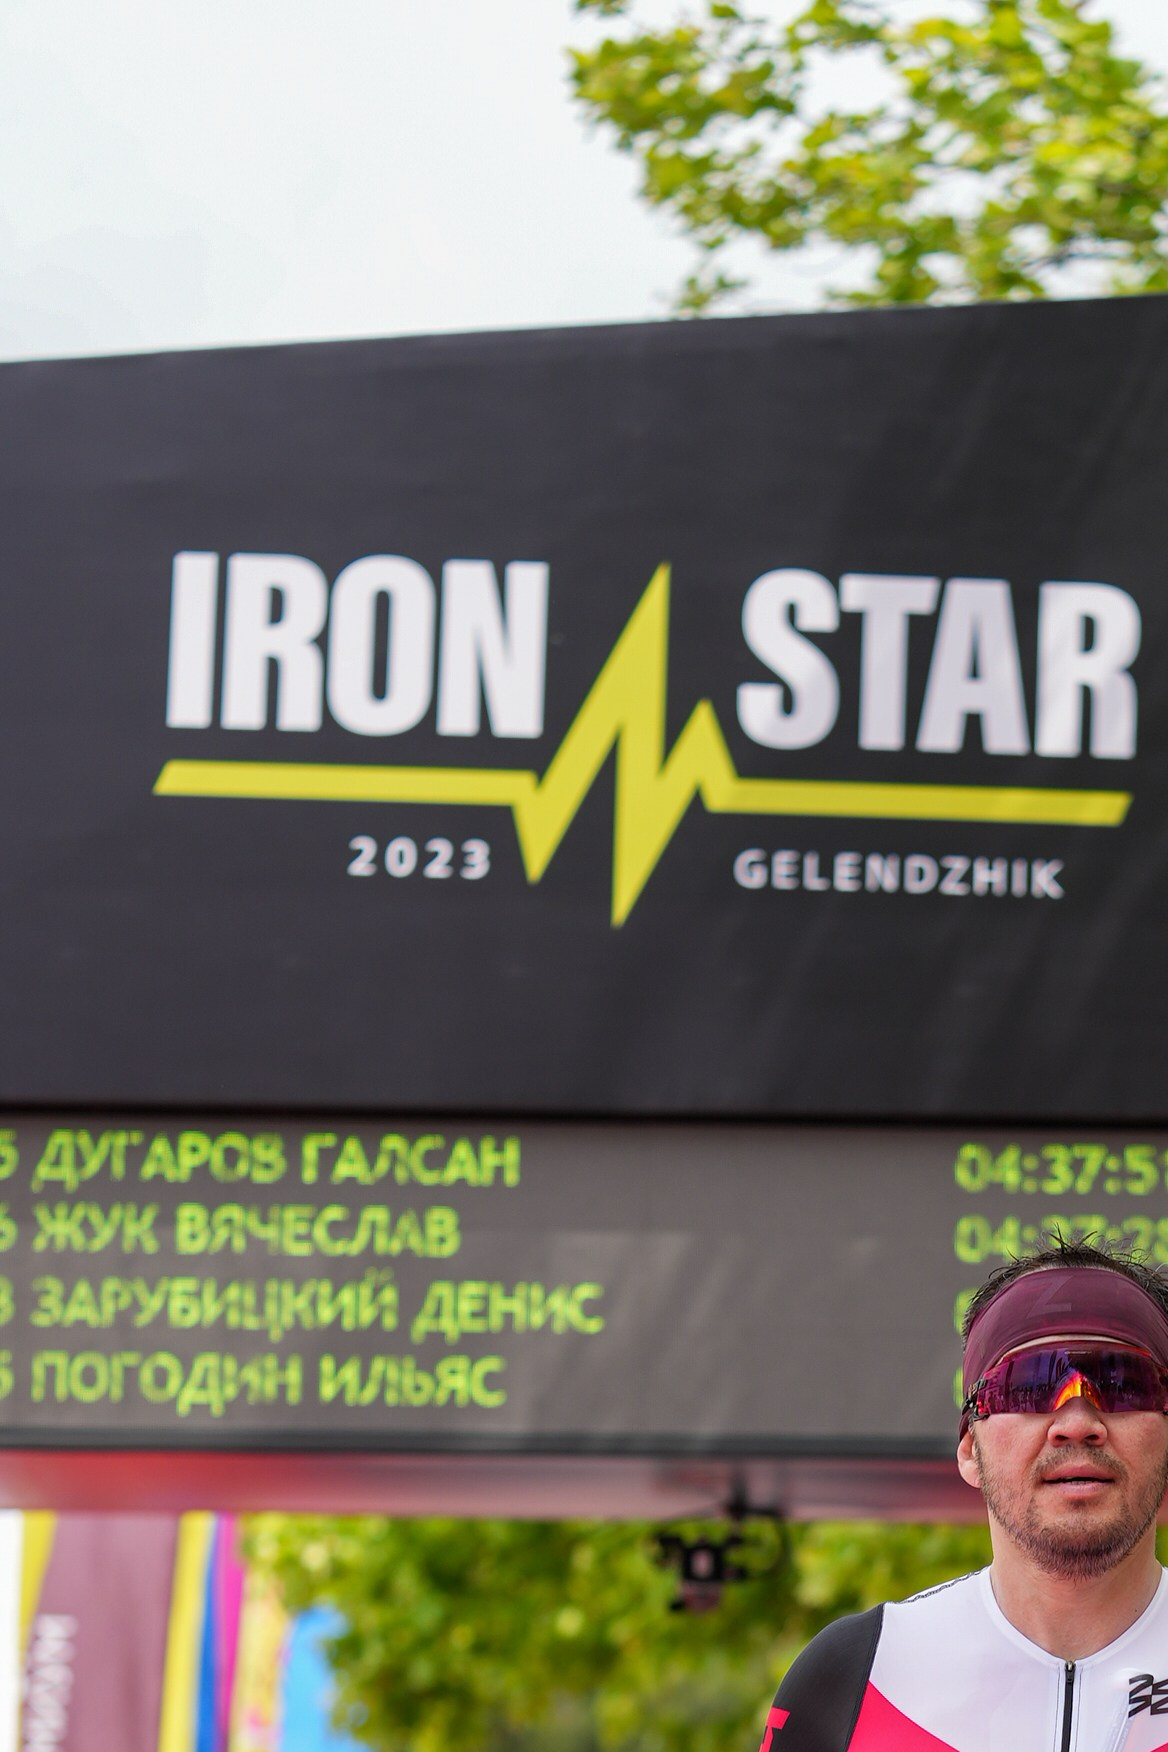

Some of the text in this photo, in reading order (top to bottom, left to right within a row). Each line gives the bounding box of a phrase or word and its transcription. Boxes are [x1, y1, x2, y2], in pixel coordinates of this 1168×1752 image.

[166, 551, 1142, 760] IRON STAR
[347, 836, 1065, 900] 2023 GELENDZHIK
[31, 1129, 287, 1193] ДУГАРОВ
[301, 1132, 520, 1187] ГАЛСАН
[32, 1202, 160, 1254] ЖУК
[175, 1203, 461, 1258] ВЯЧЕСЛАВ
[30, 1267, 398, 1343] ЗАРУБИЦКИЙ
[410, 1279, 604, 1345] ДЕНИС
[31, 1350, 302, 1417] ПОГОДИН
[319, 1354, 507, 1408] ИЛЬЯС
